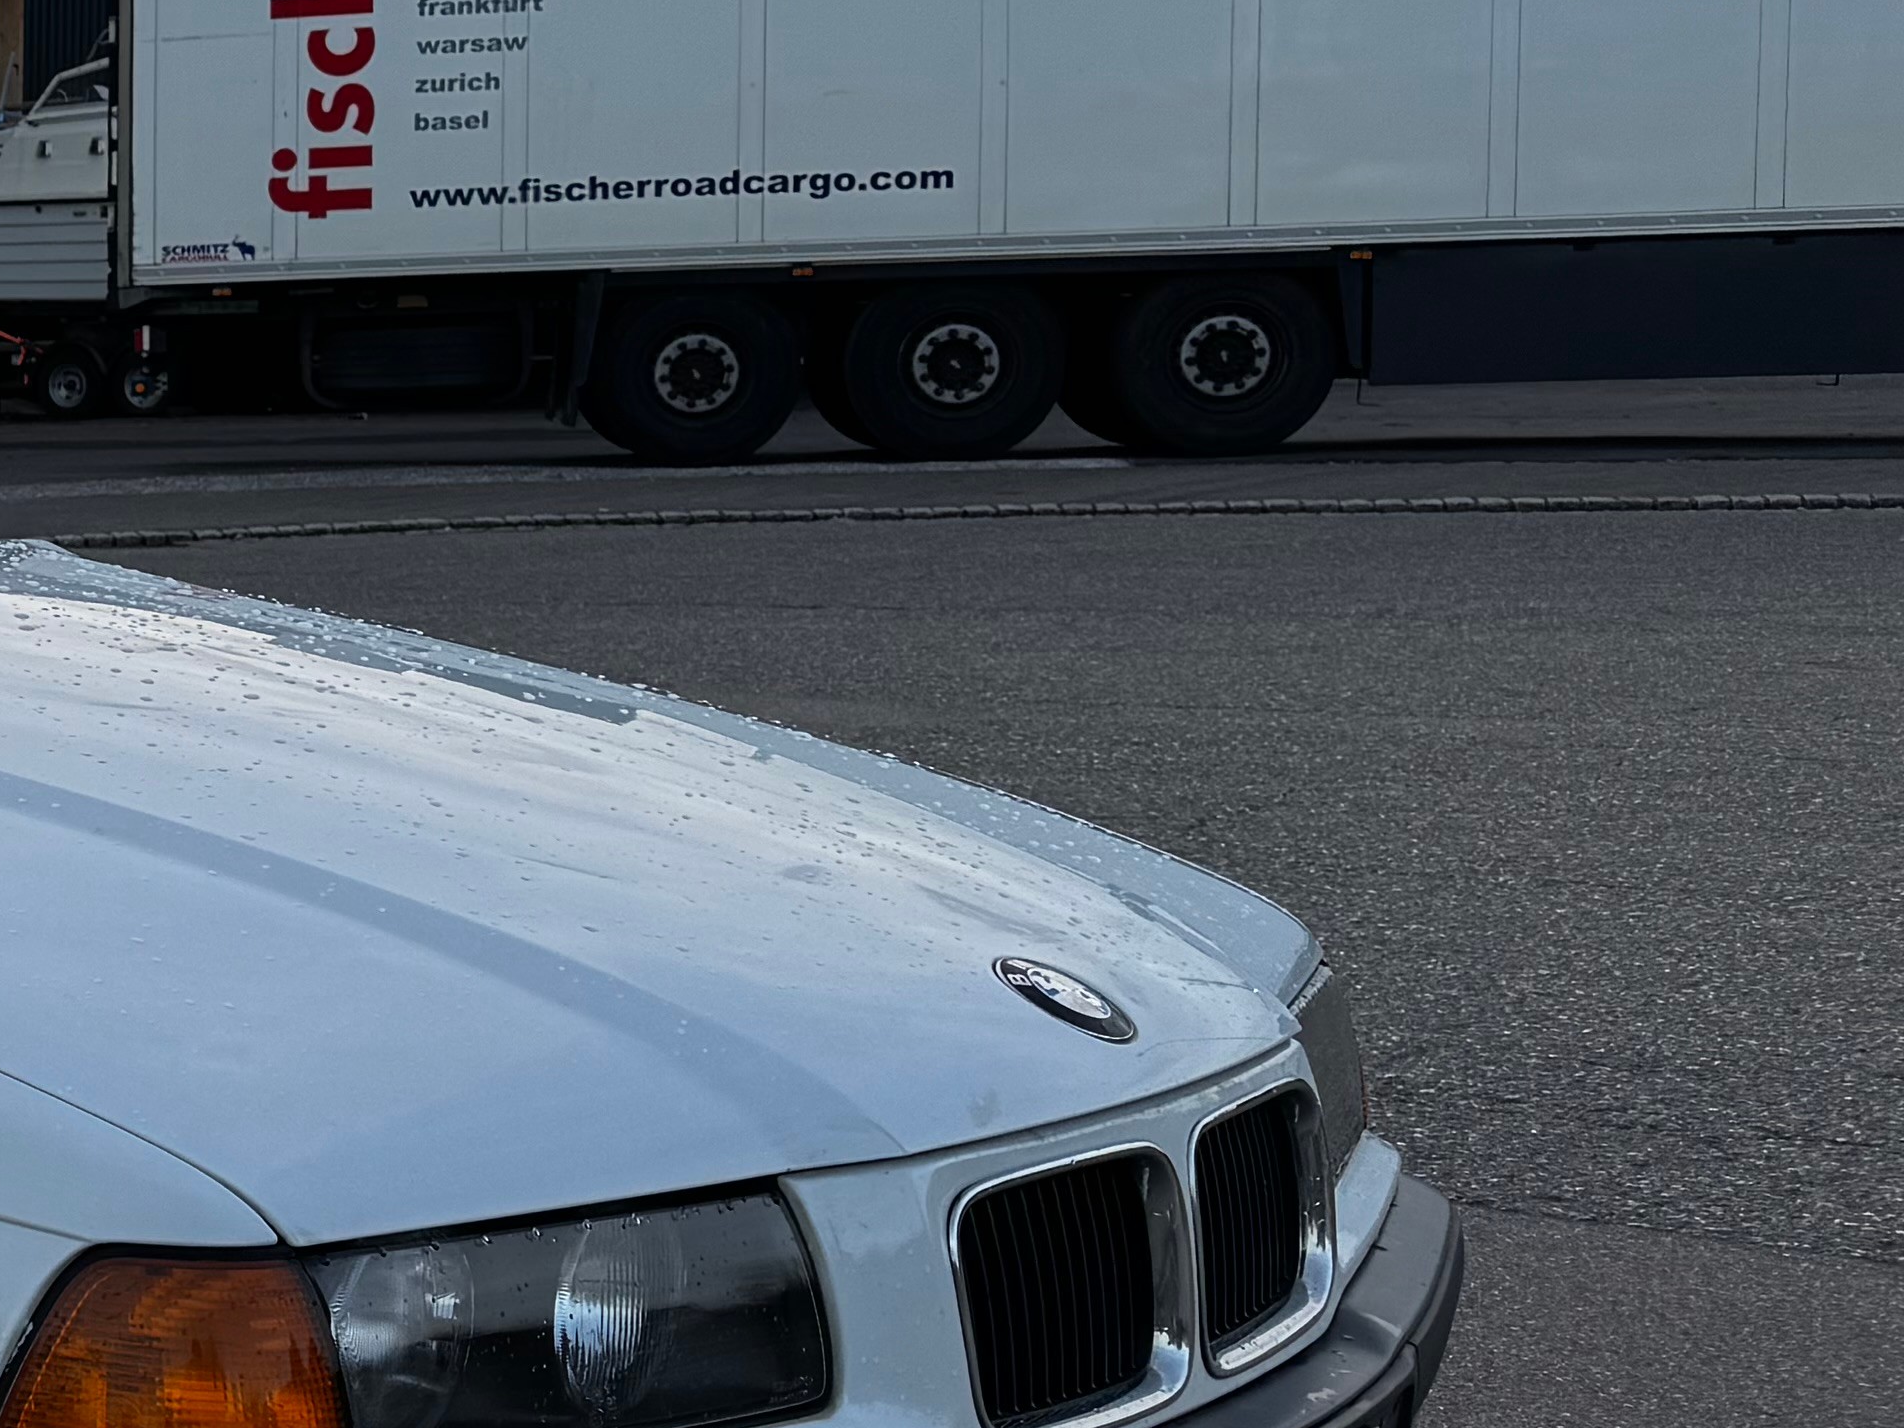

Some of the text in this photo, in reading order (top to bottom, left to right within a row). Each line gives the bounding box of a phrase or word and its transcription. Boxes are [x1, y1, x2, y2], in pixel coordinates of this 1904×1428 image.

[416, 33, 529, 55] warsaw
[414, 71, 502, 94] zurich
[414, 109, 490, 132] basel
[409, 166, 955, 209] www.fischerroadcargo.com
[161, 243, 230, 257] SCHMITZ
